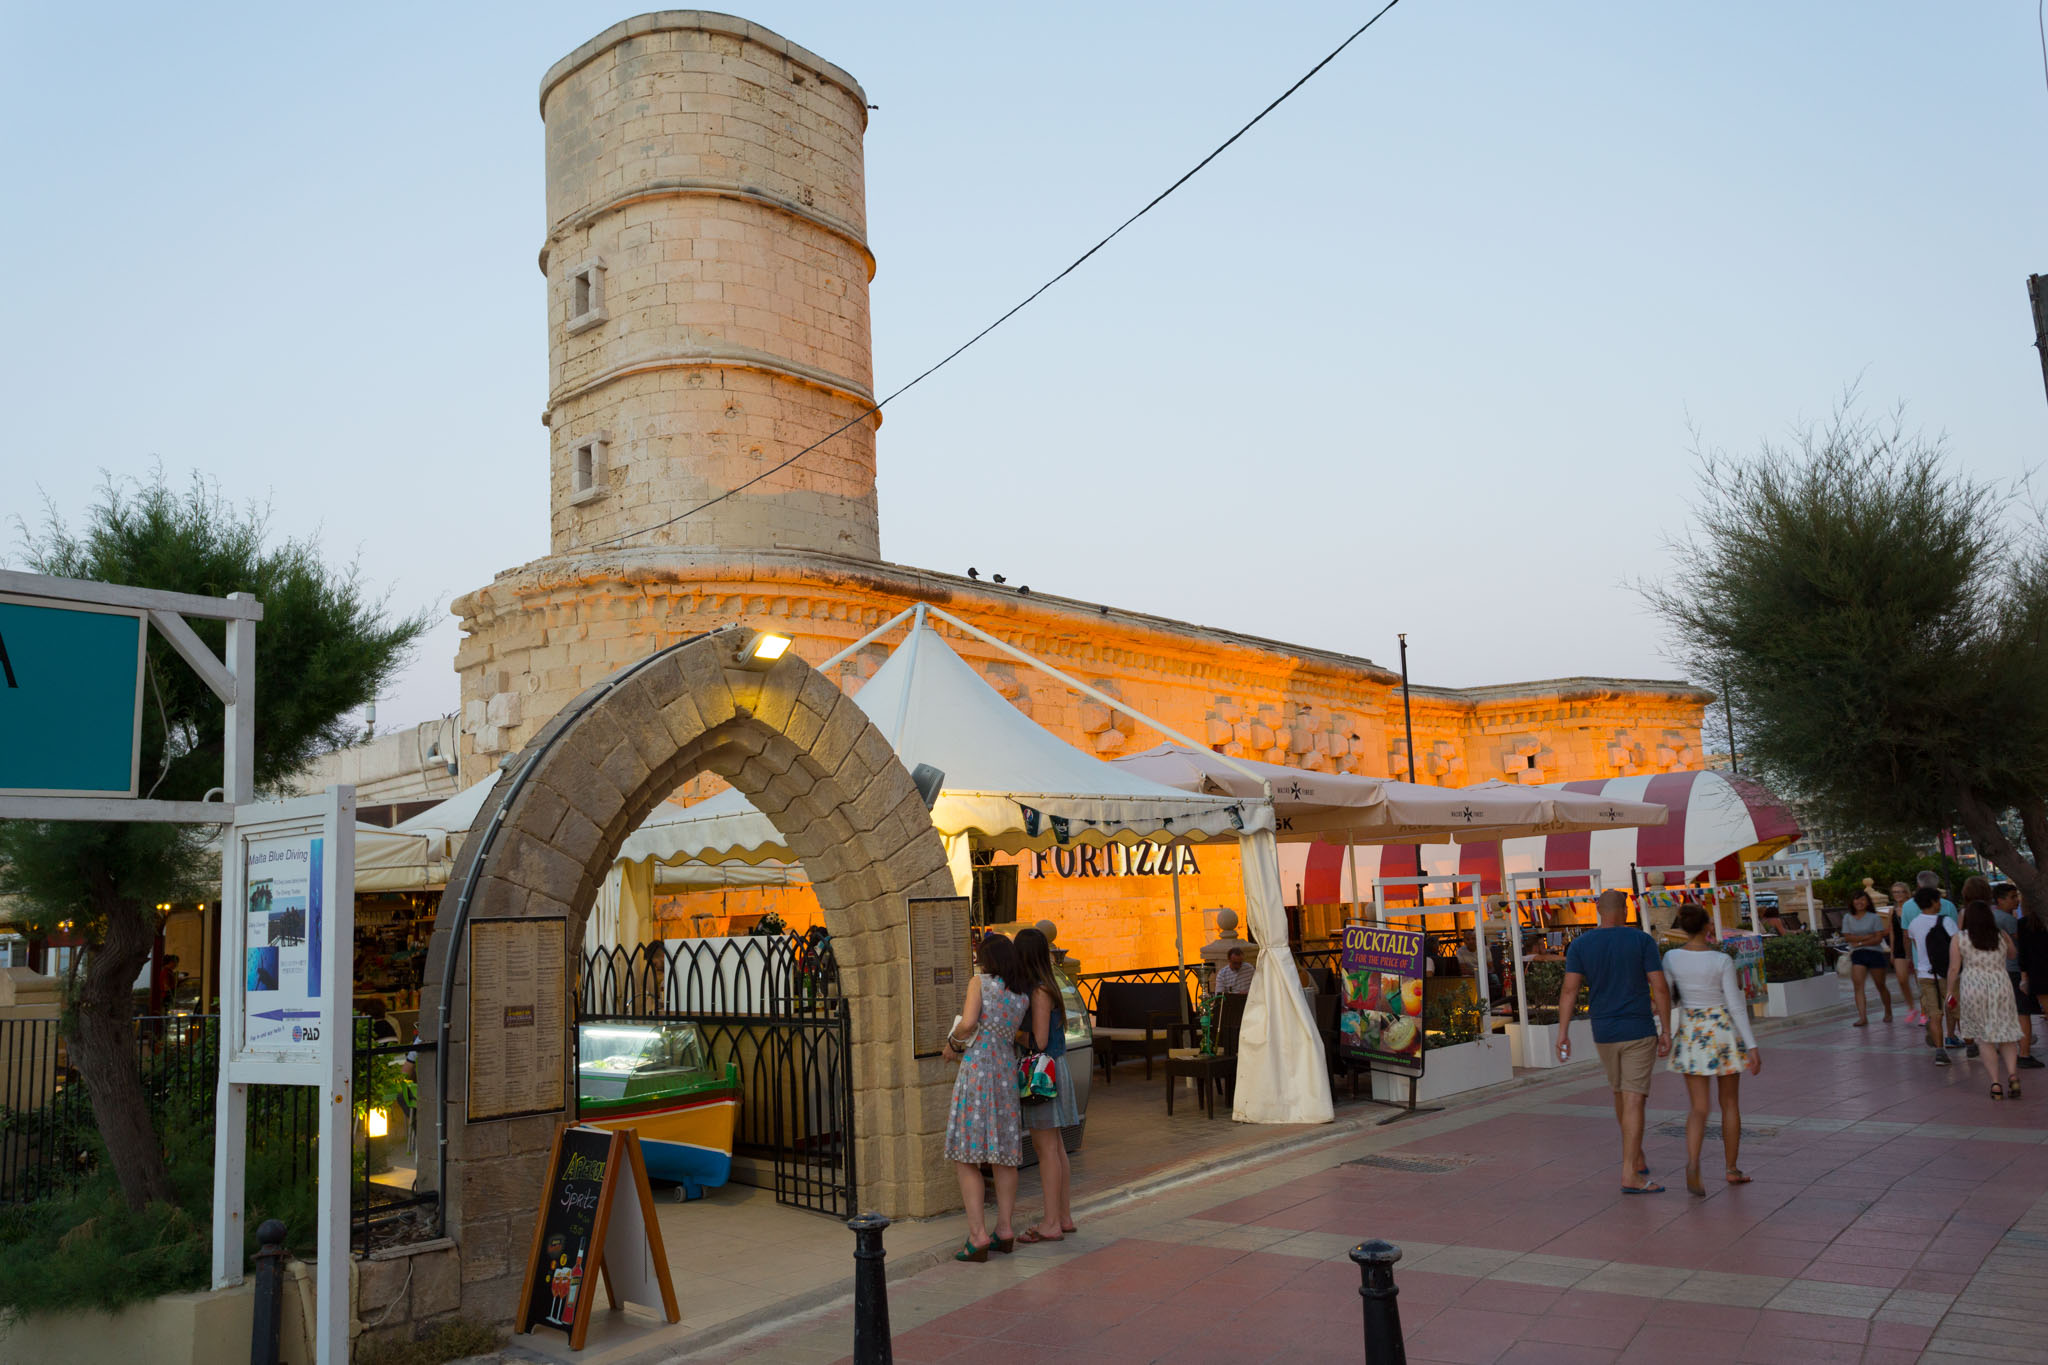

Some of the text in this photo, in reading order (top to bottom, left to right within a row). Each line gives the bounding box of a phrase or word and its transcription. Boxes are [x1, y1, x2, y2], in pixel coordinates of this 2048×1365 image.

[249, 848, 308, 866] Malta Blue Diving
[1032, 839, 1201, 879] FORTIZZA
[1346, 929, 1420, 957] COCKTAILS
[1348, 949, 1354, 962] 2
[1355, 952, 1367, 964] FOR
[1368, 954, 1379, 966] THE
[1380, 956, 1398, 969] PRICE
[1399, 958, 1409, 970] OF
[1410, 957, 1415, 970] 1
